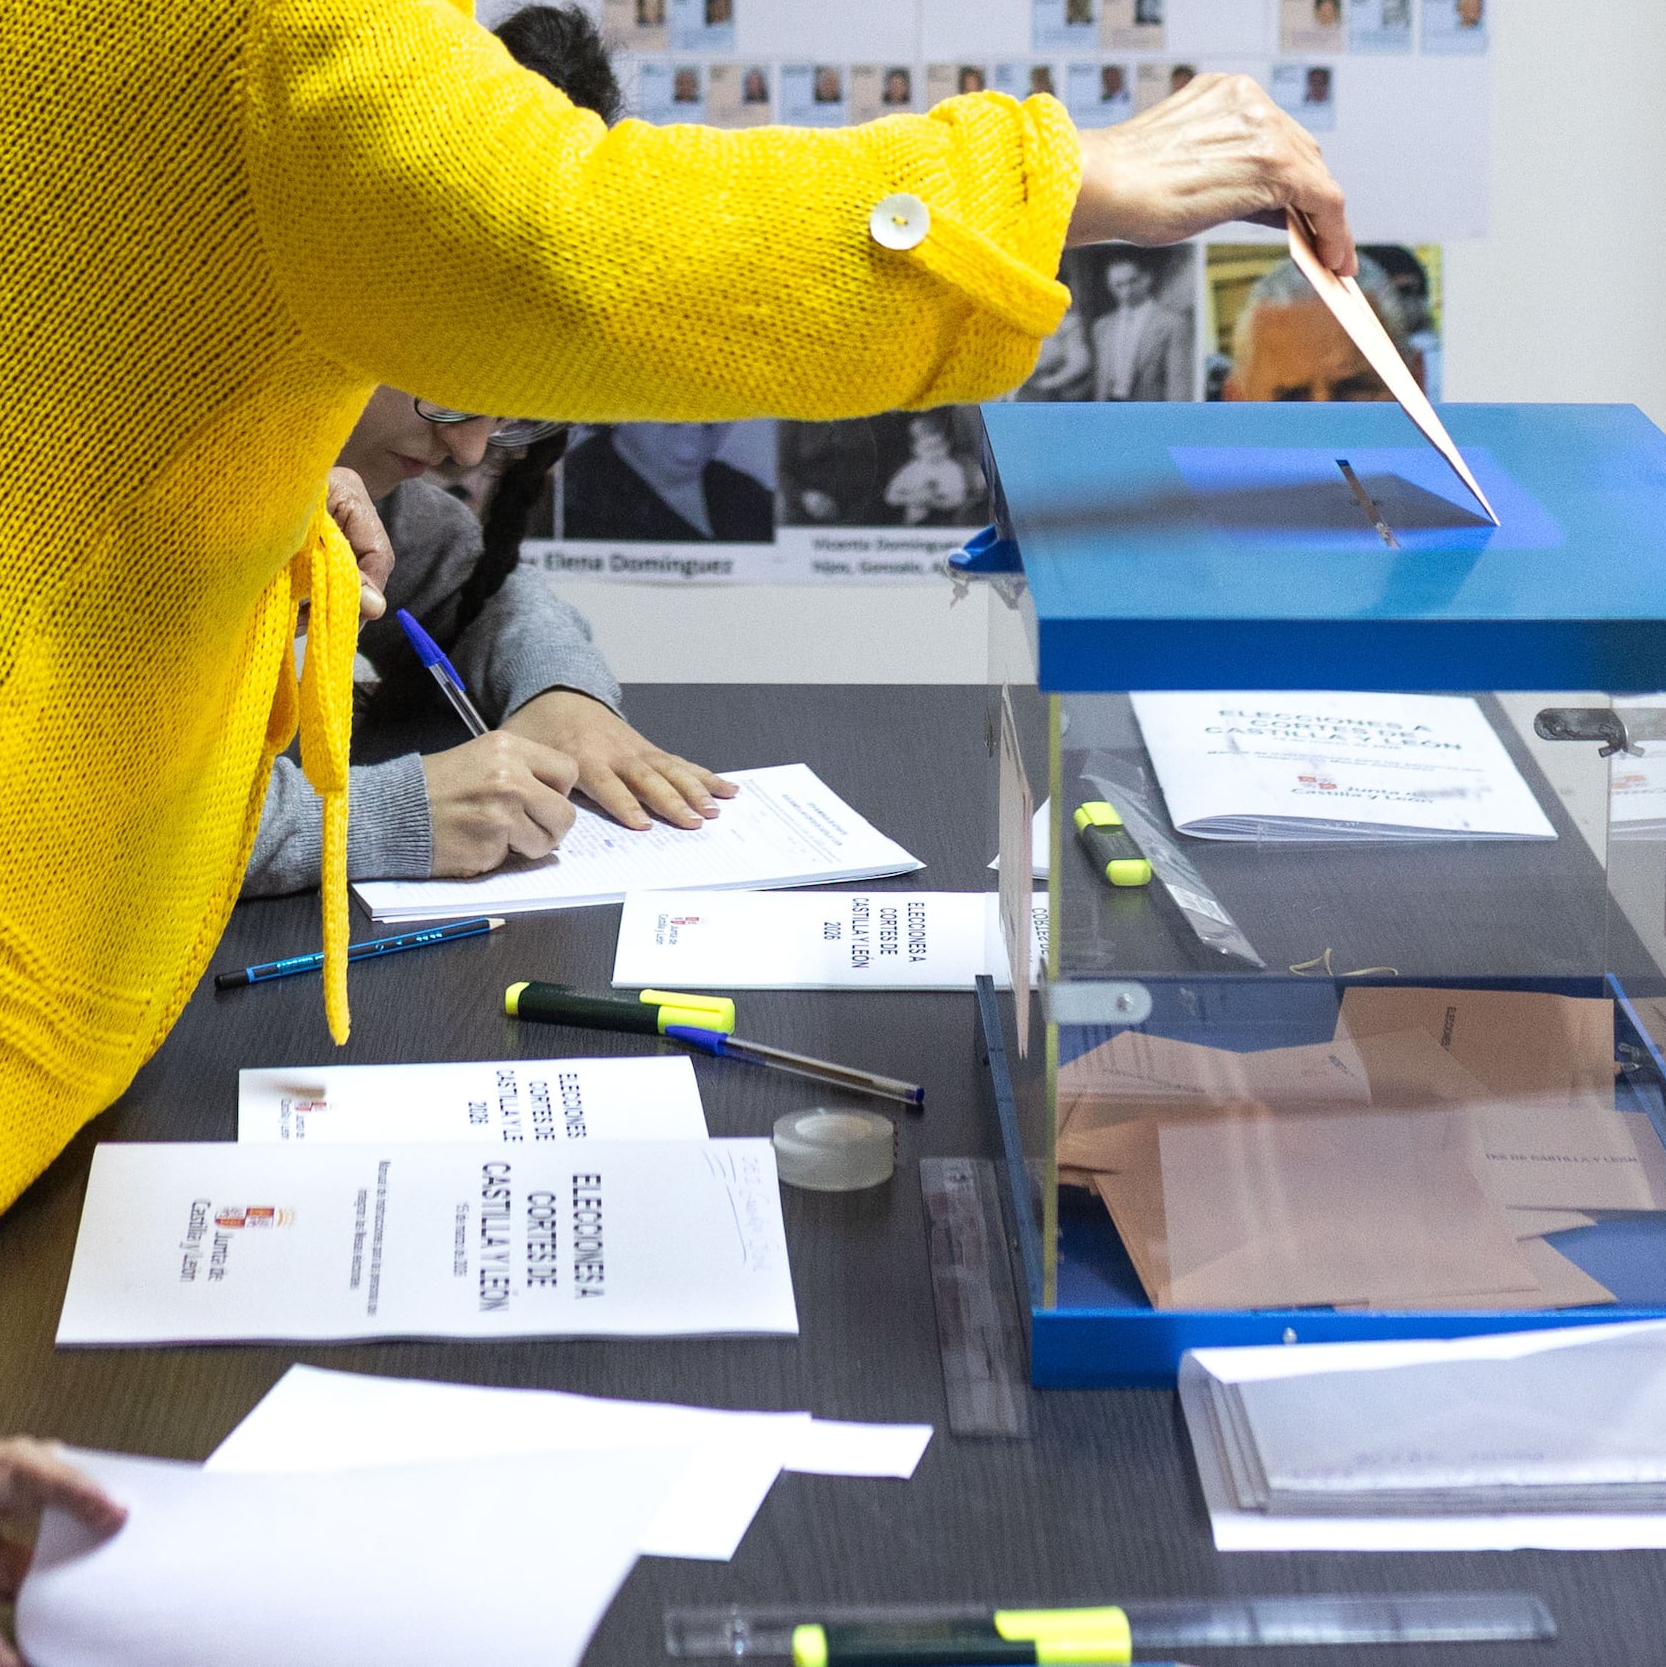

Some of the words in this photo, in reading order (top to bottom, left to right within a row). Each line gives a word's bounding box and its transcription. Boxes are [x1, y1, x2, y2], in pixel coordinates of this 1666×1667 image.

[544, 551, 604, 572] Elena
[1219, 709, 1403, 729] ELECCIONES
[1414, 724, 1433, 733] A
[1250, 718, 1368, 736] CORTES
[1378, 728, 1417, 739] DE
[1205, 726, 1346, 741] CASTILLA
[851, 897, 870, 936] CASTILLA
[879, 907, 898, 941] CORTES
[907, 901, 927, 954] ELECCIONES
[823, 921, 841, 940] 2026
[851, 944, 875, 969] LEÓN
[880, 943, 898, 955] DE
[908, 955, 927, 963] A
[496, 1069, 520, 1118] CASTILLA
[528, 1081, 553, 1122] CORTES
[467, 1101, 489, 1125] 2026
[558, 1073, 587, 1139] ELECCIONES
[502, 1119, 522, 1127] Y
[534, 1127, 556, 1141] DE
[481, 1161, 511, 1249] CASTILLA
[186, 1198, 211, 1242] Castilla
[527, 1190, 557, 1262] CORTES
[572, 1173, 604, 1283] ELECCIONES
[212, 1231, 235, 1264] Junta
[481, 1251, 510, 1264] Y
[207, 1266, 228, 1282] de
[527, 1267, 557, 1288] DE
[479, 1267, 519, 1312] LEÓN
[574, 1284, 605, 1299] A
